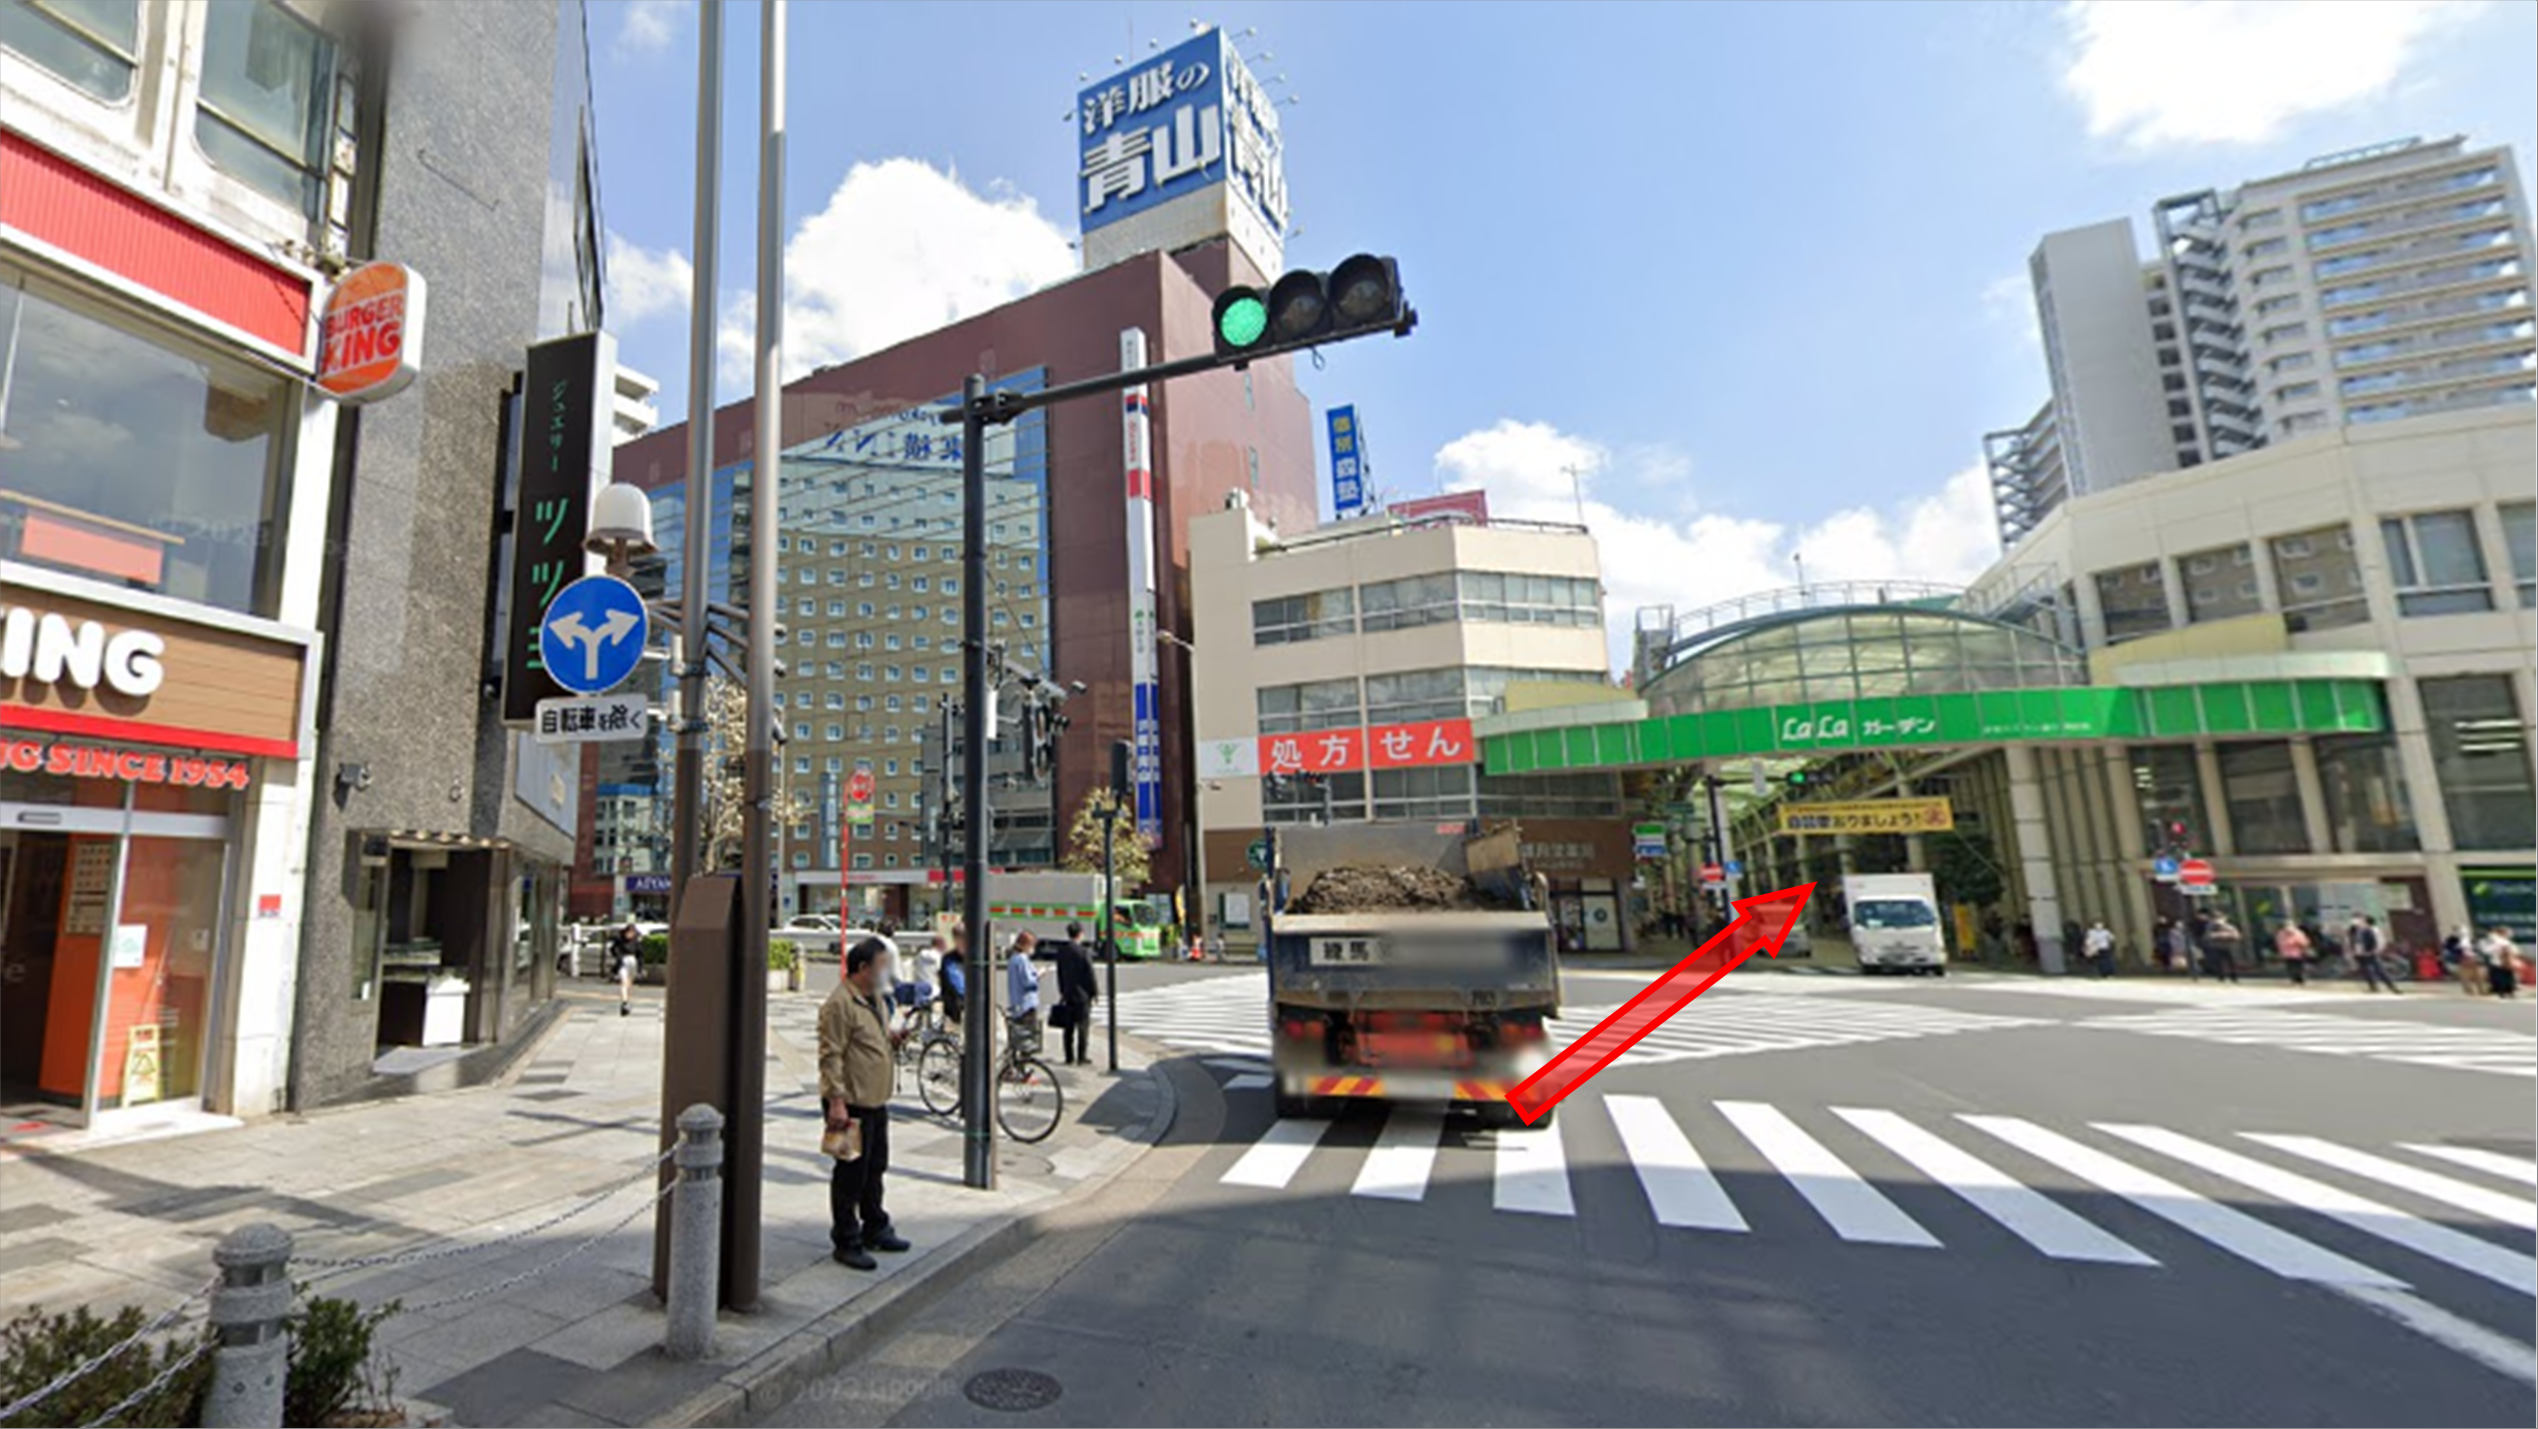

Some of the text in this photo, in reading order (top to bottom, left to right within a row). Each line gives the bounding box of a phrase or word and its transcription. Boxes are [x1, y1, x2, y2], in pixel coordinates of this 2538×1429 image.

[1083, 59, 1210, 134] 洋服の
[1079, 103, 1221, 216] 青山
[326, 293, 405, 340] BURGER
[320, 320, 402, 377] KING
[0, 607, 165, 695] ING
[542, 704, 642, 734] 自転車を除く
[46, 742, 165, 783] SINCE
[170, 757, 250, 790] 1954
[1270, 726, 1461, 770] 処方せん
